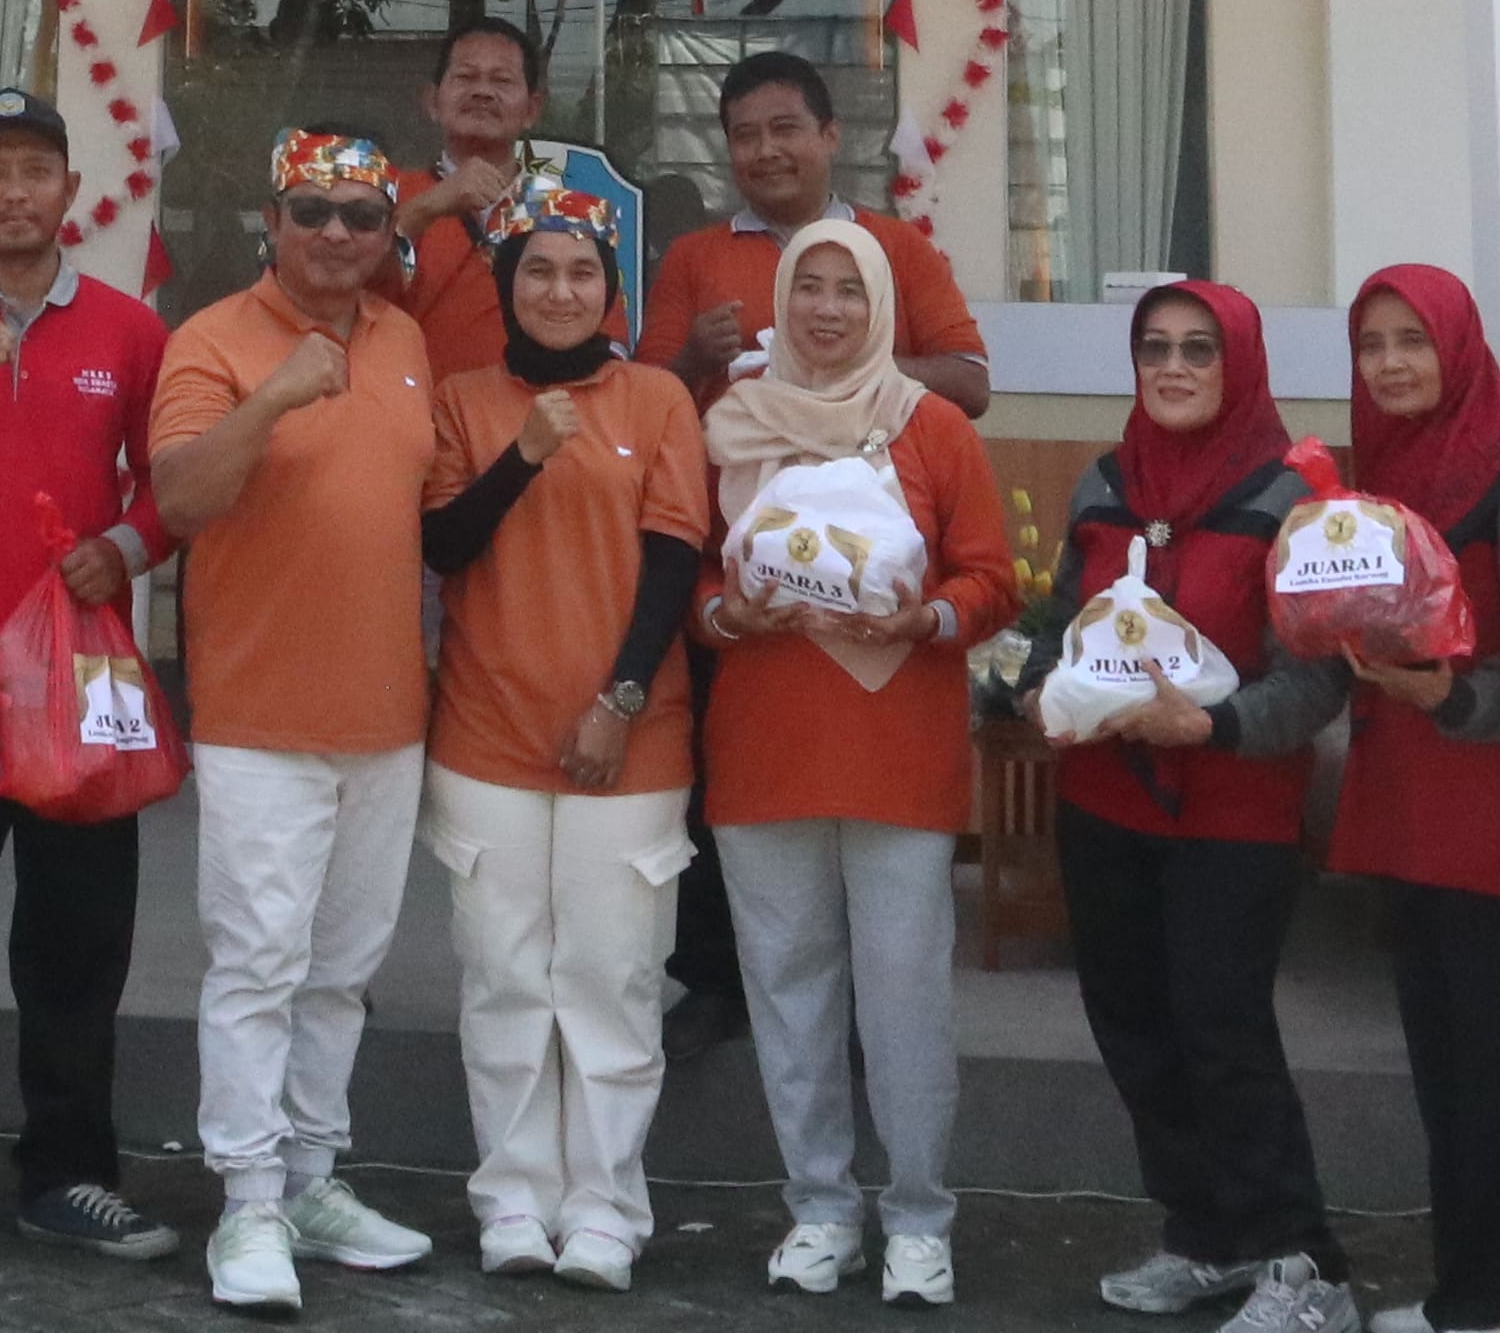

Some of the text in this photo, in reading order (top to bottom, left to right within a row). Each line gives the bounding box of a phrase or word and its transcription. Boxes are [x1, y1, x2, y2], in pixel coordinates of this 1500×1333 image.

[1297, 555, 1383, 577] JUARA 1
[757, 564, 826, 595] JUARA
[830, 584, 843, 598] 3
[1168, 656, 1181, 670] 2
[129, 718, 141, 733] 2
